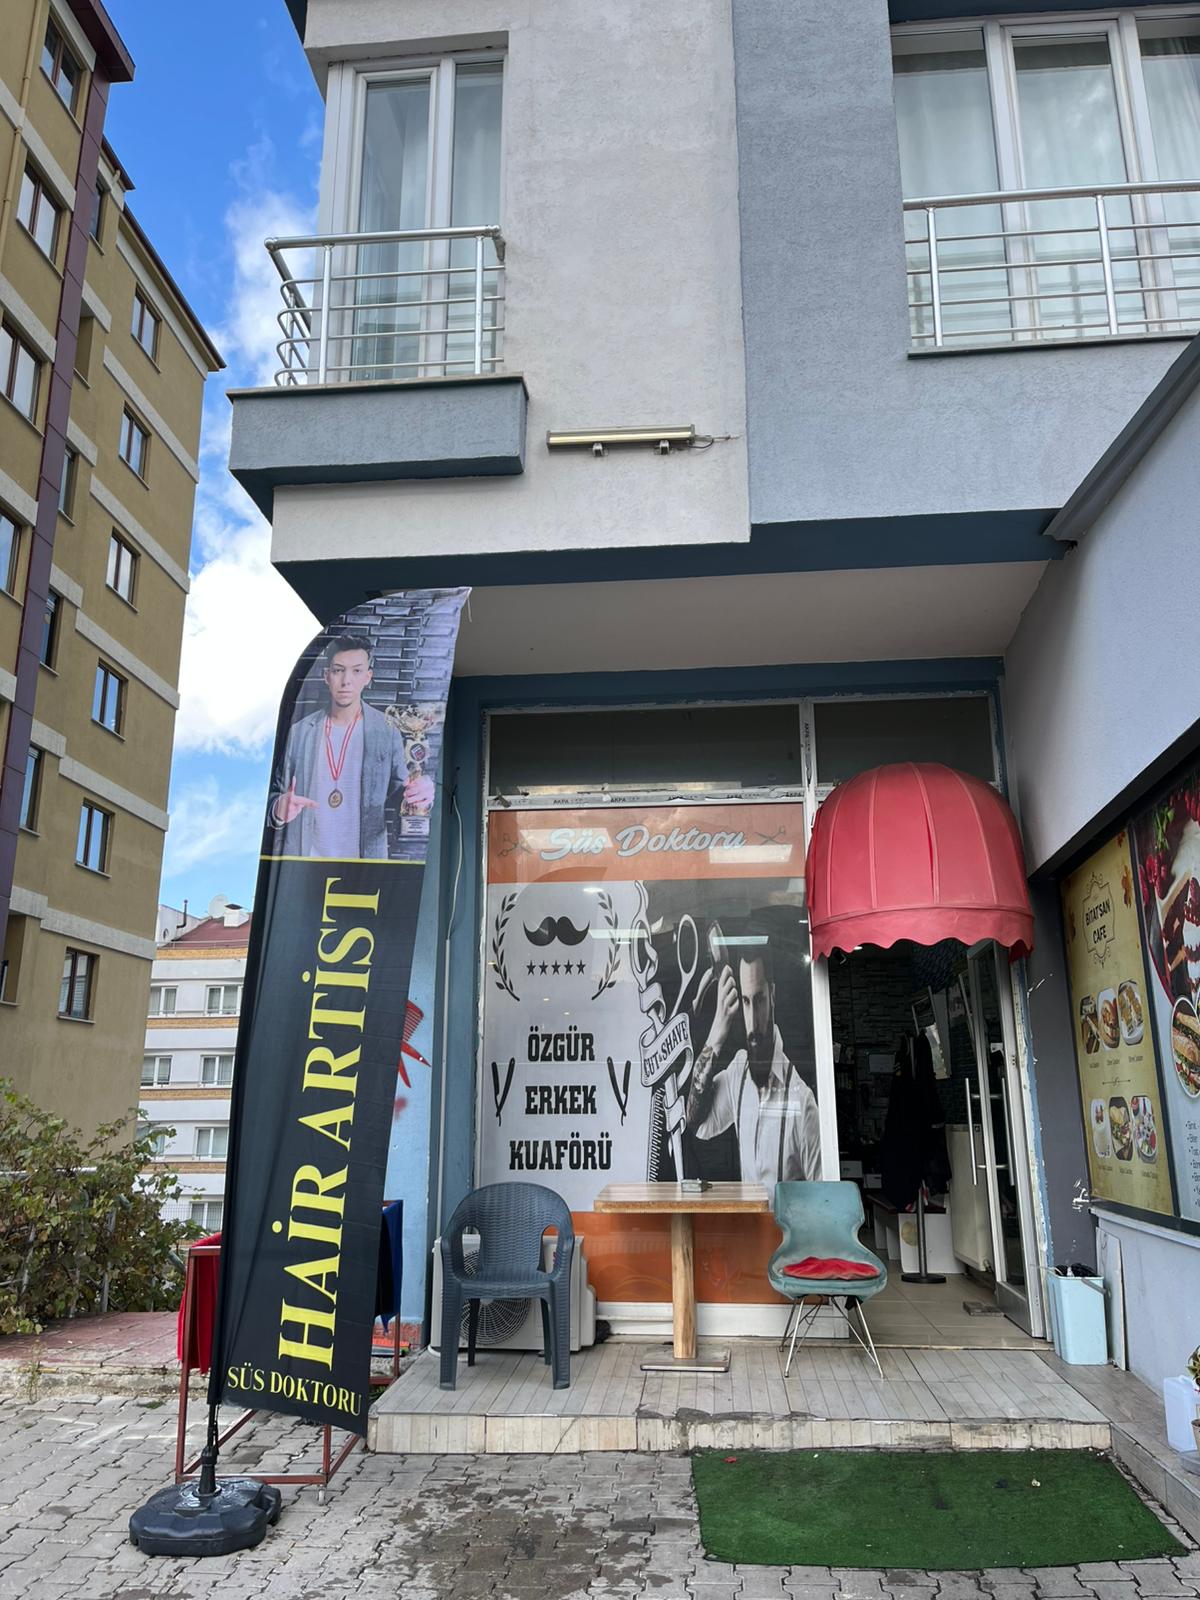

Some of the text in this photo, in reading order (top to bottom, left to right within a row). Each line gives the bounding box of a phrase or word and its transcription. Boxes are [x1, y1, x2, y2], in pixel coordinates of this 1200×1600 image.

[540, 825, 748, 861] Süs Doktoru
[1092, 924, 1107, 944] CAFE
[527, 1025, 595, 1062] ÖZGÜR
[525, 1085, 598, 1115] ERKEK
[271, 877, 381, 1371] HAİR ARTİST
[509, 1131, 613, 1170] KUAFÖRÜ
[227, 1363, 362, 1416] SÜS DOKTORU
